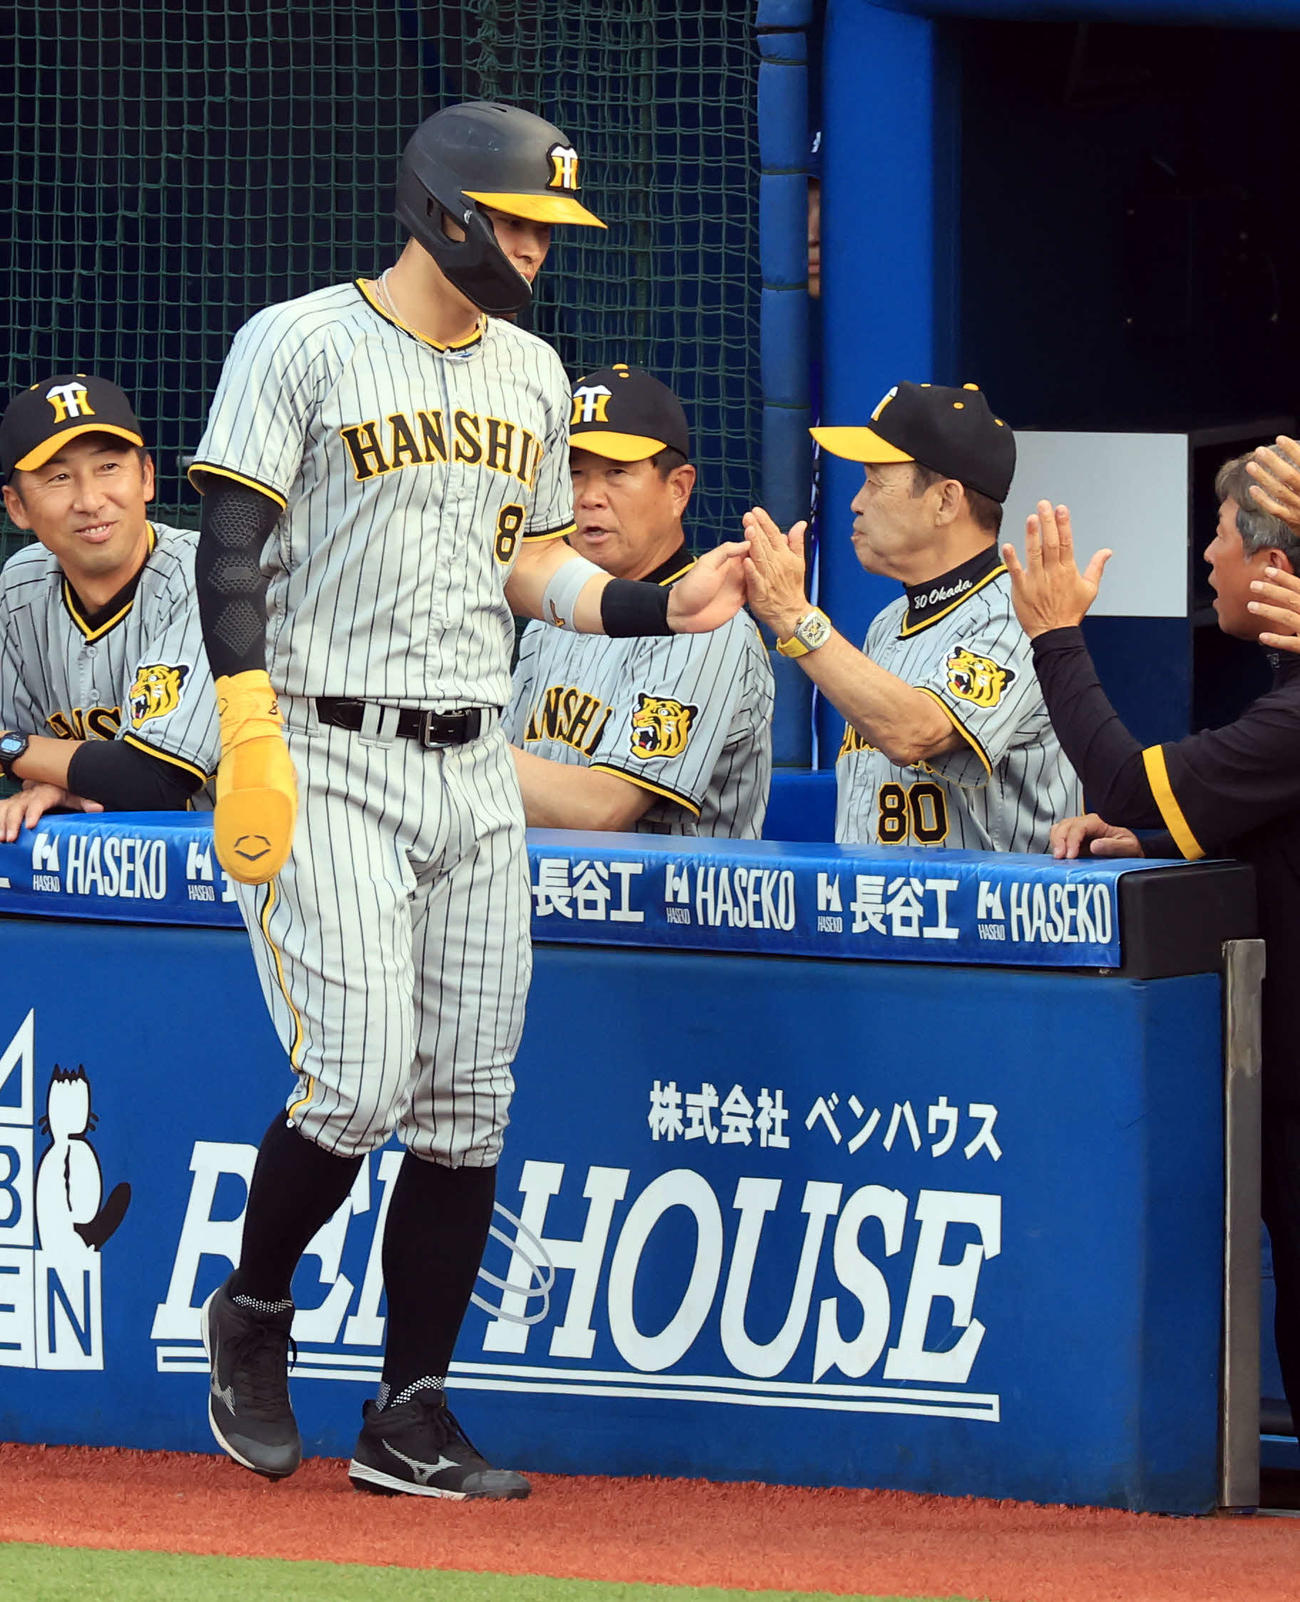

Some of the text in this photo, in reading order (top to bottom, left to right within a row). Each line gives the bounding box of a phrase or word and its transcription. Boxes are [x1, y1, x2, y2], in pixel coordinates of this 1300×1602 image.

[340, 409, 543, 492] HANSHI
[494, 502, 527, 565] 8
[929, 579, 973, 604] Okada
[877, 782, 949, 844] 80
[65, 834, 167, 900] HASEKO
[531, 858, 645, 922] 長谷工
[695, 866, 796, 931] HASEKO
[850, 874, 960, 939] 長谷工
[1010, 882, 1112, 944] HASEKO
[648, 1080, 790, 1149] 株式会社
[482, 1160, 1001, 1384] HOUSE
